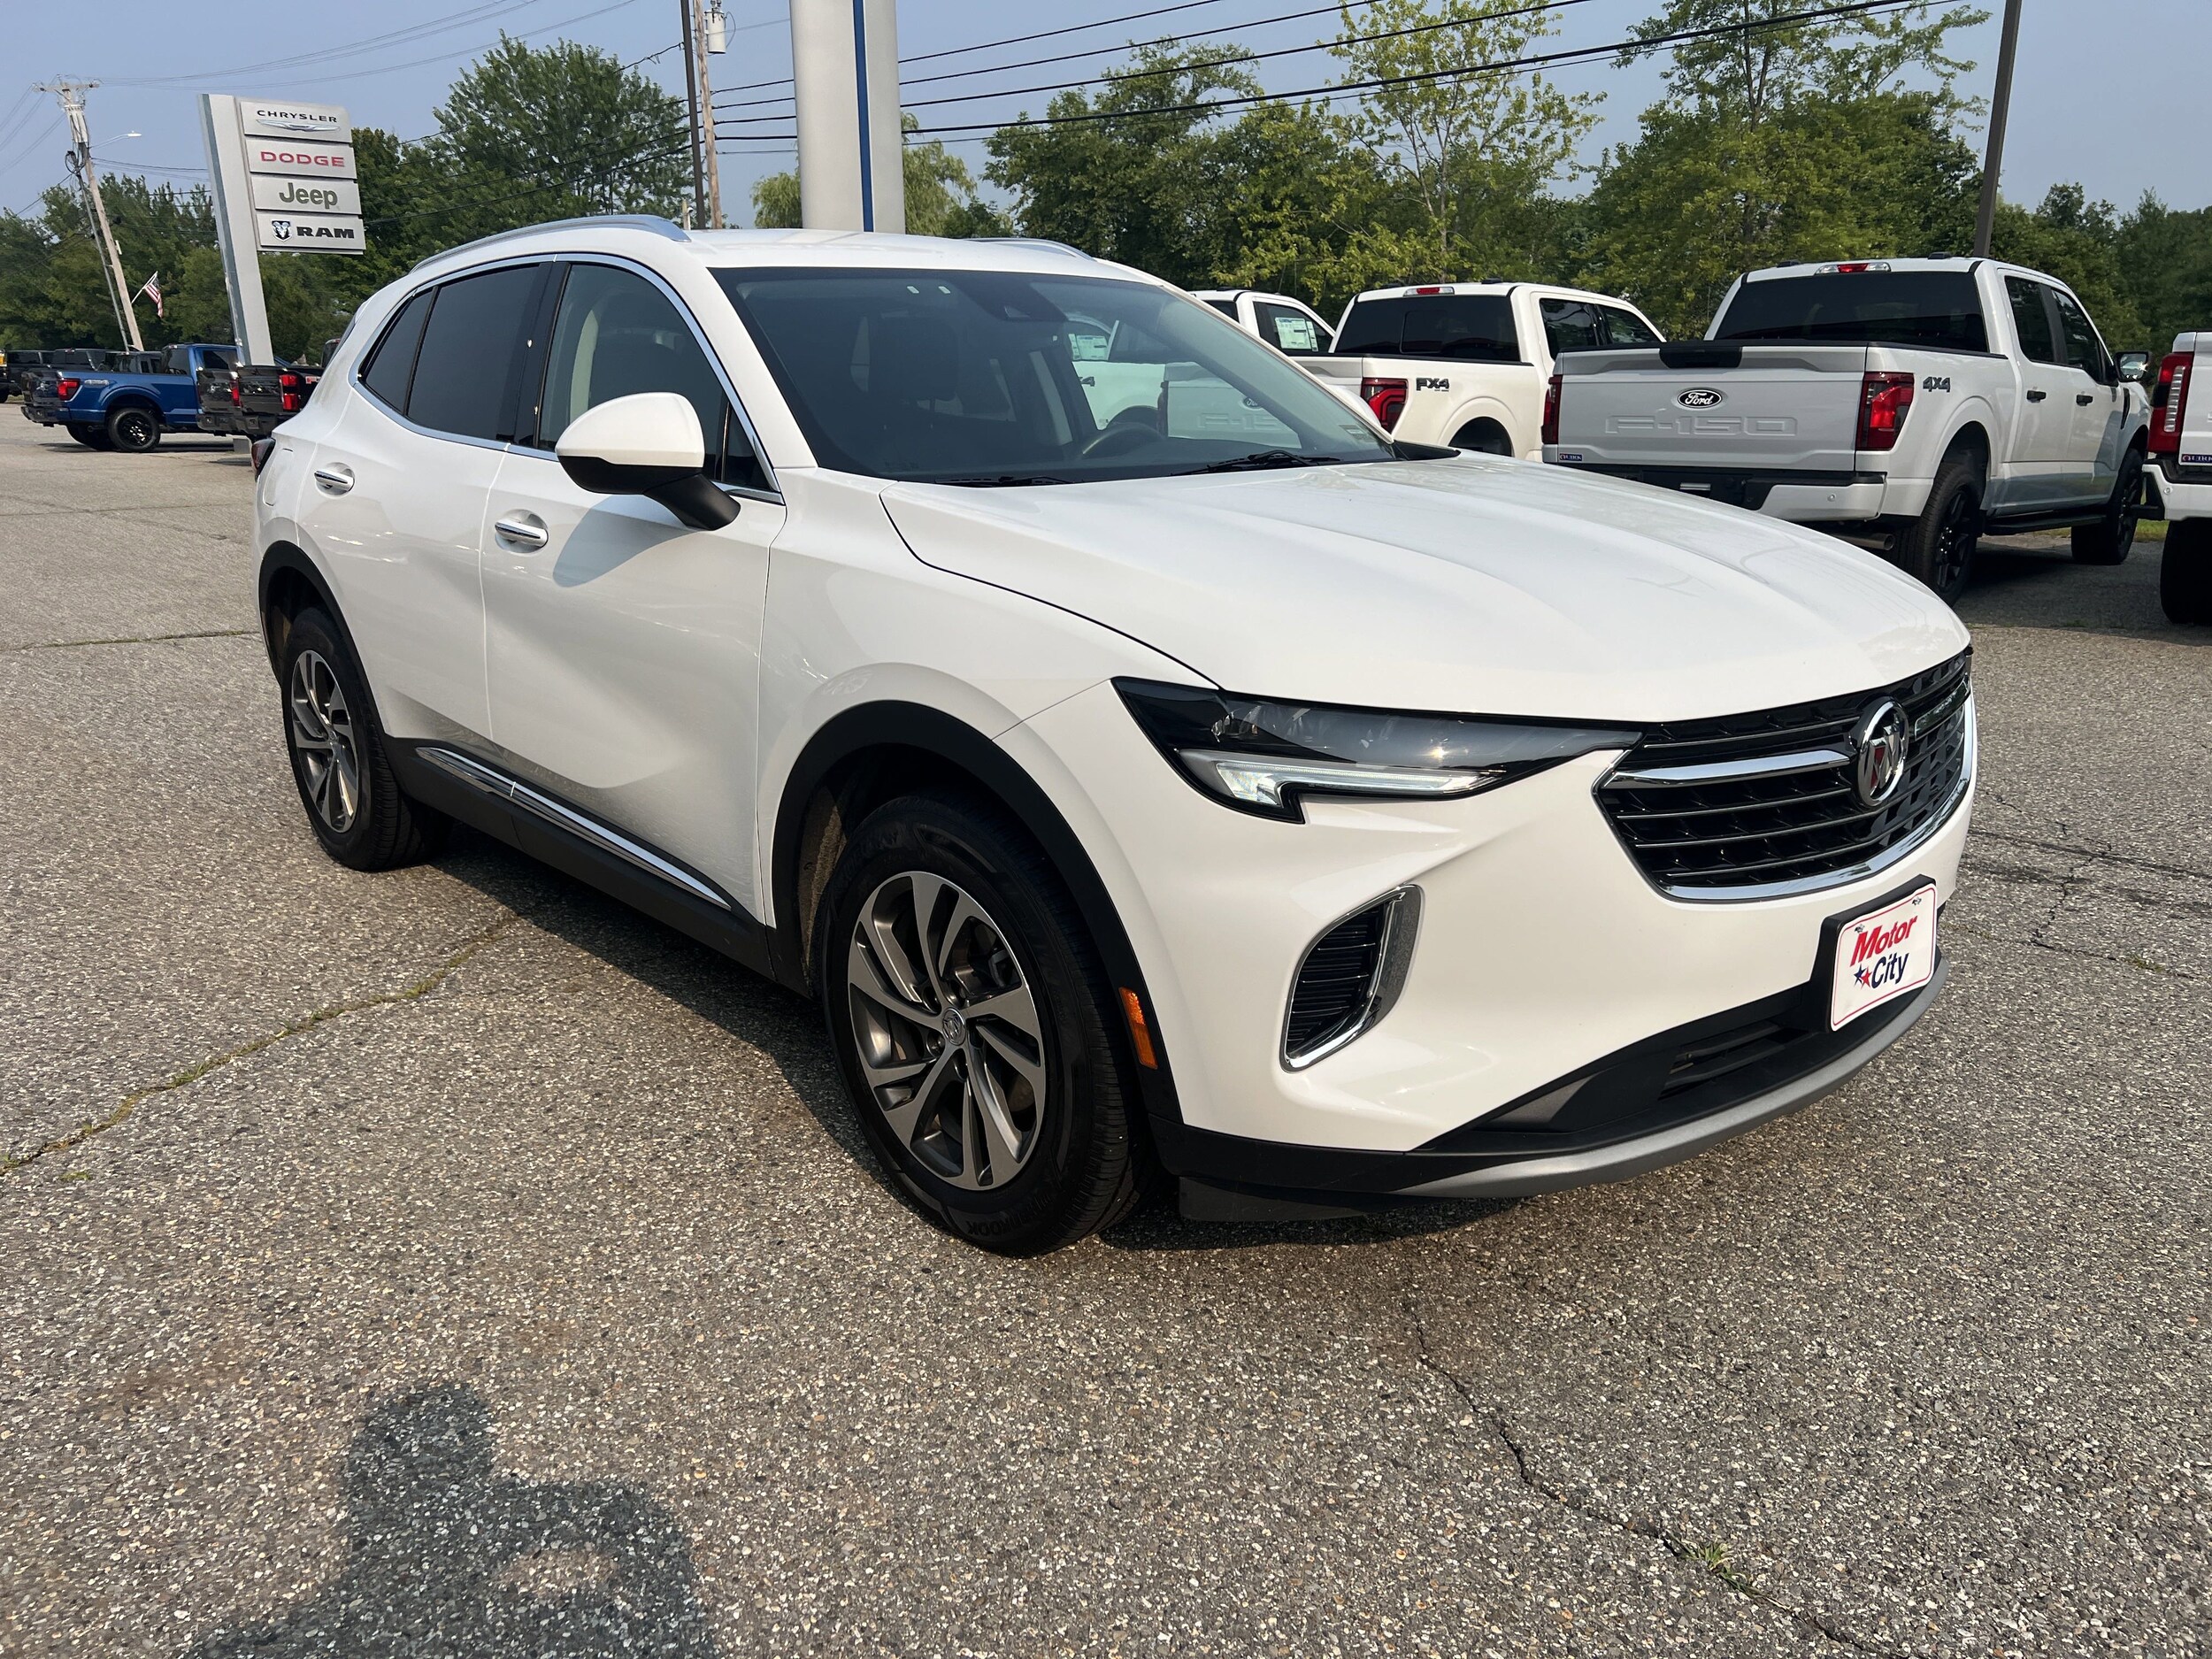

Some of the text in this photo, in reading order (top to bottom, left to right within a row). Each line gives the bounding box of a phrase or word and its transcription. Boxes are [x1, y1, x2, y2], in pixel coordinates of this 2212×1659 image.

[257, 110, 338, 123] CHRYSLER
[260, 150, 345, 167] DODGE
[279, 182, 338, 210] Jeep
[296, 226, 355, 239] RAM
[1416, 378, 1450, 391] FX4
[1684, 392, 1715, 405] Ford
[1605, 415, 1798, 436] F-150
[1849, 915, 1918, 967] Motor
[1871, 952, 1909, 989] City
